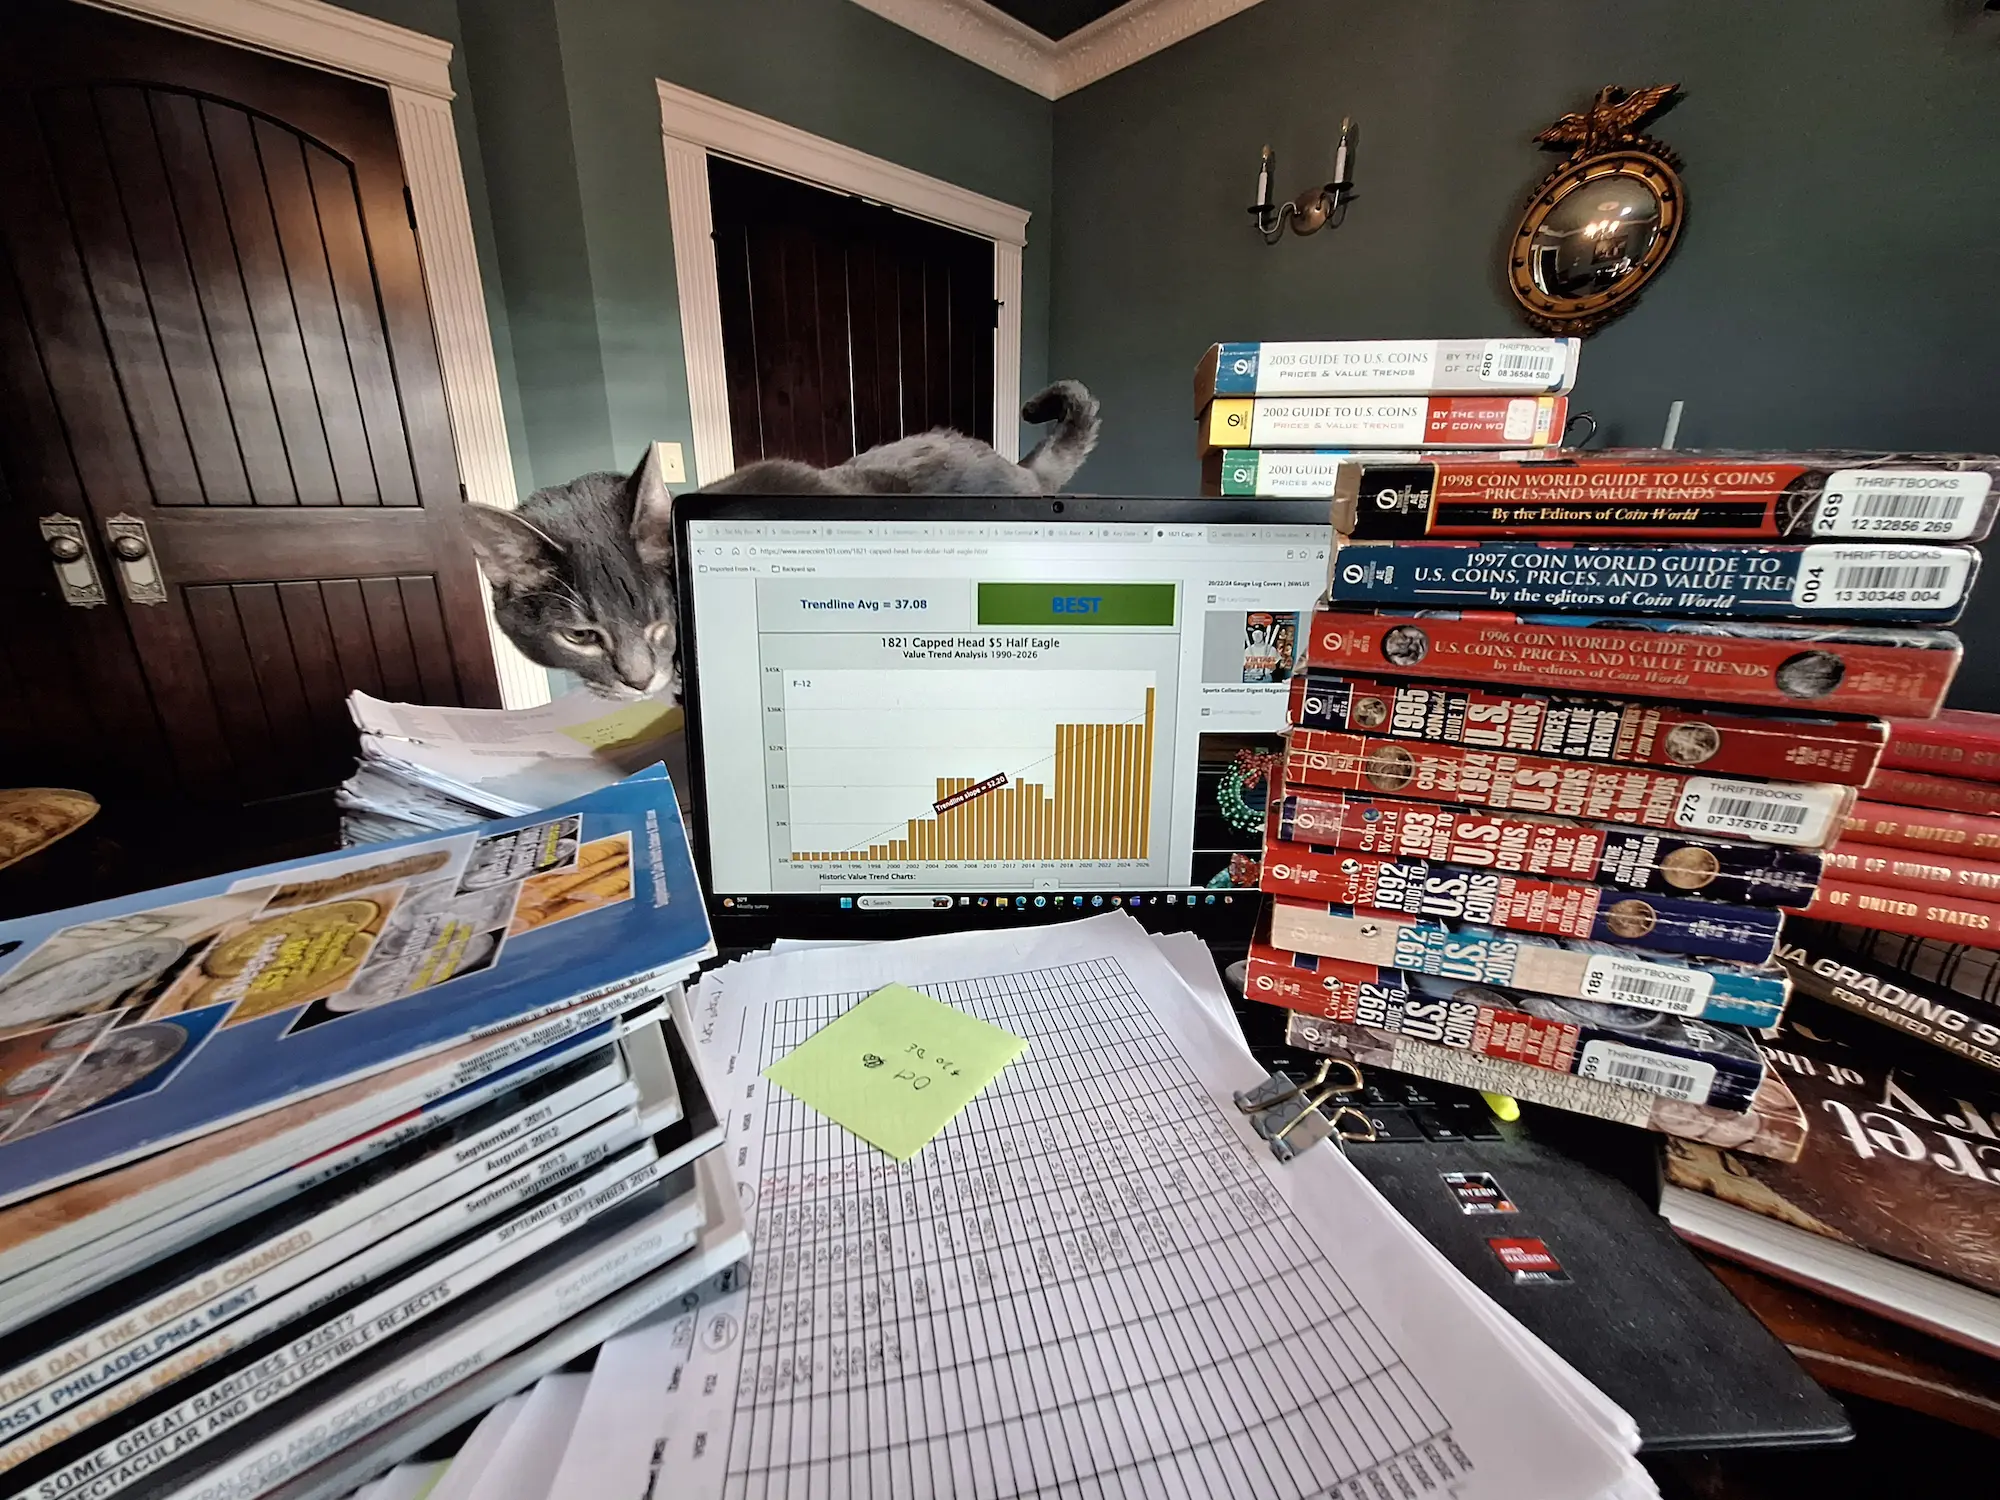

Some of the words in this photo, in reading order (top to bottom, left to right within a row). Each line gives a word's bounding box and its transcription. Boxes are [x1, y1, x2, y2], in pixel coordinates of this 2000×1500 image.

[1269, 354, 1295, 365] 2003
[1299, 354, 1338, 365] GUIDE
[1342, 354, 1360, 364] TO
[1364, 353, 1384, 364] U.S.
[1388, 352, 1428, 364] COINS
[1482, 353, 1493, 376] 580
[1280, 370, 1317, 378] PRICES
[1322, 369, 1329, 378] &
[1333, 369, 1369, 377] VALUE
[1374, 368, 1415, 376] TRENDS
[1509, 370, 1532, 378] 36584
[1263, 407, 1288, 417] 2002
[1292, 407, 1330, 417] GUIDE
[1333, 407, 1351, 417] TO
[1354, 407, 1374, 417] U.S.
[1378, 407, 1417, 417] COINS
[1268, 465, 1293, 476] 2001
[1296, 464, 1334, 475] GUIDE
[1442, 475, 1474, 487] 1998
[1477, 475, 1521, 487] COIN
[1525, 474, 1586, 487] WORLD
[1595, 474, 1647, 486] GUIDE
[1653, 473, 1677, 484] TO
[1714, 472, 1775, 485] COINS
[1855, 477, 1959, 489] THRIFTBOOKS
[1492, 508, 1510, 522] By
[1514, 508, 1536, 519] the
[1539, 508, 1591, 520] Editors
[1595, 508, 1612, 520] of
[1615, 508, 1648, 520] Coin
[1652, 507, 1700, 521] World
[1819, 493, 1843, 530] 269
[1851, 519, 1868, 530] 12
[1872, 520, 1918, 532] 32856
[1923, 521, 1952, 533] 269
[1467, 553, 1507, 568] 1997
[1510, 554, 1567, 569] COIN
[1574, 554, 1657, 571] WORLD
[1662, 556, 1739, 573] GUIDE
[1747, 557, 1781, 573] TO
[1834, 550, 1942, 561] THRIFTBOOKS
[1414, 567, 1446, 582] U.S.
[1451, 569, 1520, 584] COINS,
[1527, 570, 1600, 586] PRICES,
[1605, 572, 1658, 587] AND
[1664, 574, 1731, 591] VALUE
[1802, 566, 1824, 603] 004
[800, 599, 854, 609] Trendline
[857, 599, 879, 611] Avg
[895, 599, 927, 609] 37.08
[1052, 597, 1103, 613] BEST
[1489, 588, 1510, 603] by
[1513, 588, 1541, 600] the
[1545, 589, 1605, 605] editors
[1612, 590, 1630, 604] of
[1633, 592, 1674, 606] Coin
[1681, 594, 1734, 609] World
[881, 637, 908, 648] 1821
[912, 637, 954, 651] Capped
[958, 637, 985, 648] Head
[988, 637, 1003, 649] $5
[1006, 636, 1028, 648] Half
[1031, 637, 1060, 651] Eagle
[903, 650, 925, 659] Value
[927, 650, 952, 659] Trend
[954, 650, 988, 660] Analysis
[990, 650, 1038, 659] 1990-2026
[1391, 689, 1429, 738] 1995
[1457, 753, 1494, 804] 1994
[1709, 782, 1804, 801] THRIFTBOOKS
[935, 796, 964, 811] Trendline
[964, 788, 981, 799] slope
[987, 776, 1005, 788] $2.20
[1680, 794, 1701, 822] 273
[1399, 812, 1436, 856] 1993
[1707, 815, 1722, 824] 07
[1726, 818, 1769, 832] 37576
[1772, 822, 1799, 835] 273
[1374, 861, 1411, 910] 1992
[1830, 891, 1851, 905] OF
[1859, 896, 1918, 916] UNITED
[1927, 908, 1990, 929] STATES
[1586, 971, 1604, 997] 188
[1612, 962, 1691, 984] THRIFTBOOKS
[1356, 982, 1389, 1027] 1992
[1812, 958, 1969, 1031] GRADING
[455, 1124, 521, 1162] September
[524, 1106, 553, 1125] 2011
[486, 1143, 529, 1172] August
[531, 1126, 560, 1143] 2012
[466, 1174, 531, 1214] September
[559, 1178, 628, 1227] SEPTEMBER
[630, 1166, 658, 1187] 2016
[1458, 1187, 1498, 1198] RYZEN
[499, 1200, 558, 1242] SEPTEMBER
[1503, 1253, 1552, 1264] RADEON
[49, 1341, 92, 1375] DAY
[98, 1319, 139, 1350] THE
[143, 1279, 219, 1325] WORLD
[222, 1230, 313, 1286] CHANGED
[52, 1319, 202, 1406] PHILADELPHIA
[207, 1285, 258, 1322] MINT
[207, 1401, 249, 1428] AND
[253, 1329, 378, 1404] COLLECTIBLE
[378, 1282, 452, 1332] REJECTS
[39, 1451, 114, 1500] SOME
[115, 1410, 192, 1458] GREAT
[192, 1356, 287, 1415] RARITIES
[292, 1314, 358, 1358] EXIST?
[1423, 1443, 1455, 1481] 2023
[1441, 1432, 1475, 1473] 2024
[1405, 1453, 1437, 1492] 2022
